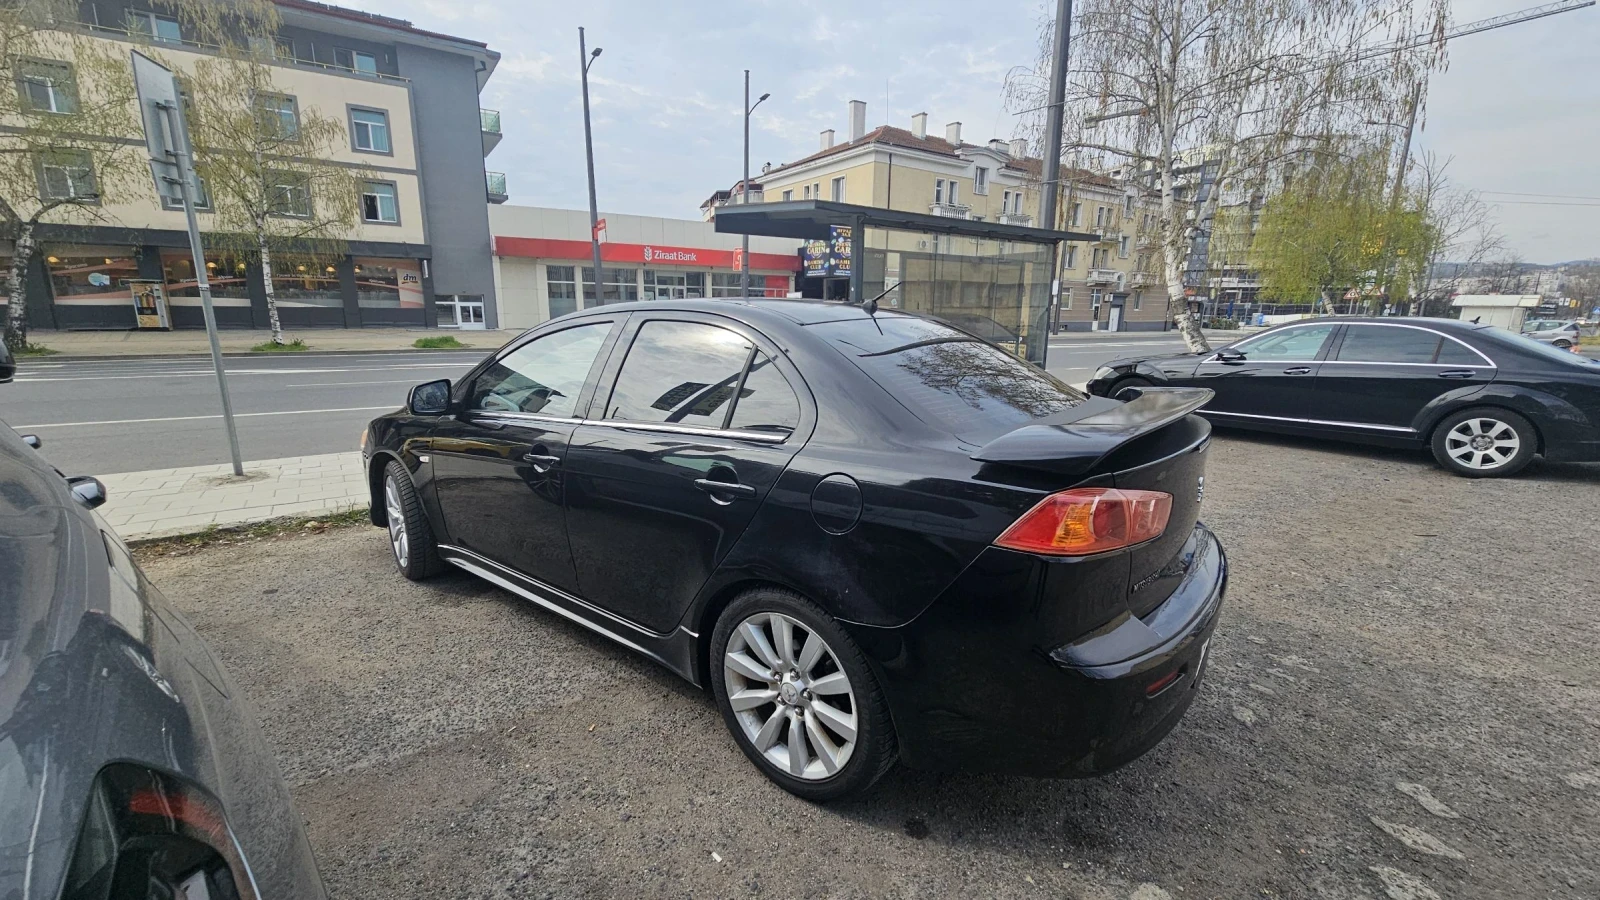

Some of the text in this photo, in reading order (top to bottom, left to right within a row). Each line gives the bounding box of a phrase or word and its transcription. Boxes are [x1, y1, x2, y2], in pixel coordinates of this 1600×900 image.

[654, 250, 697, 261] Ziraat Bank
[403, 273, 417, 281] dm
